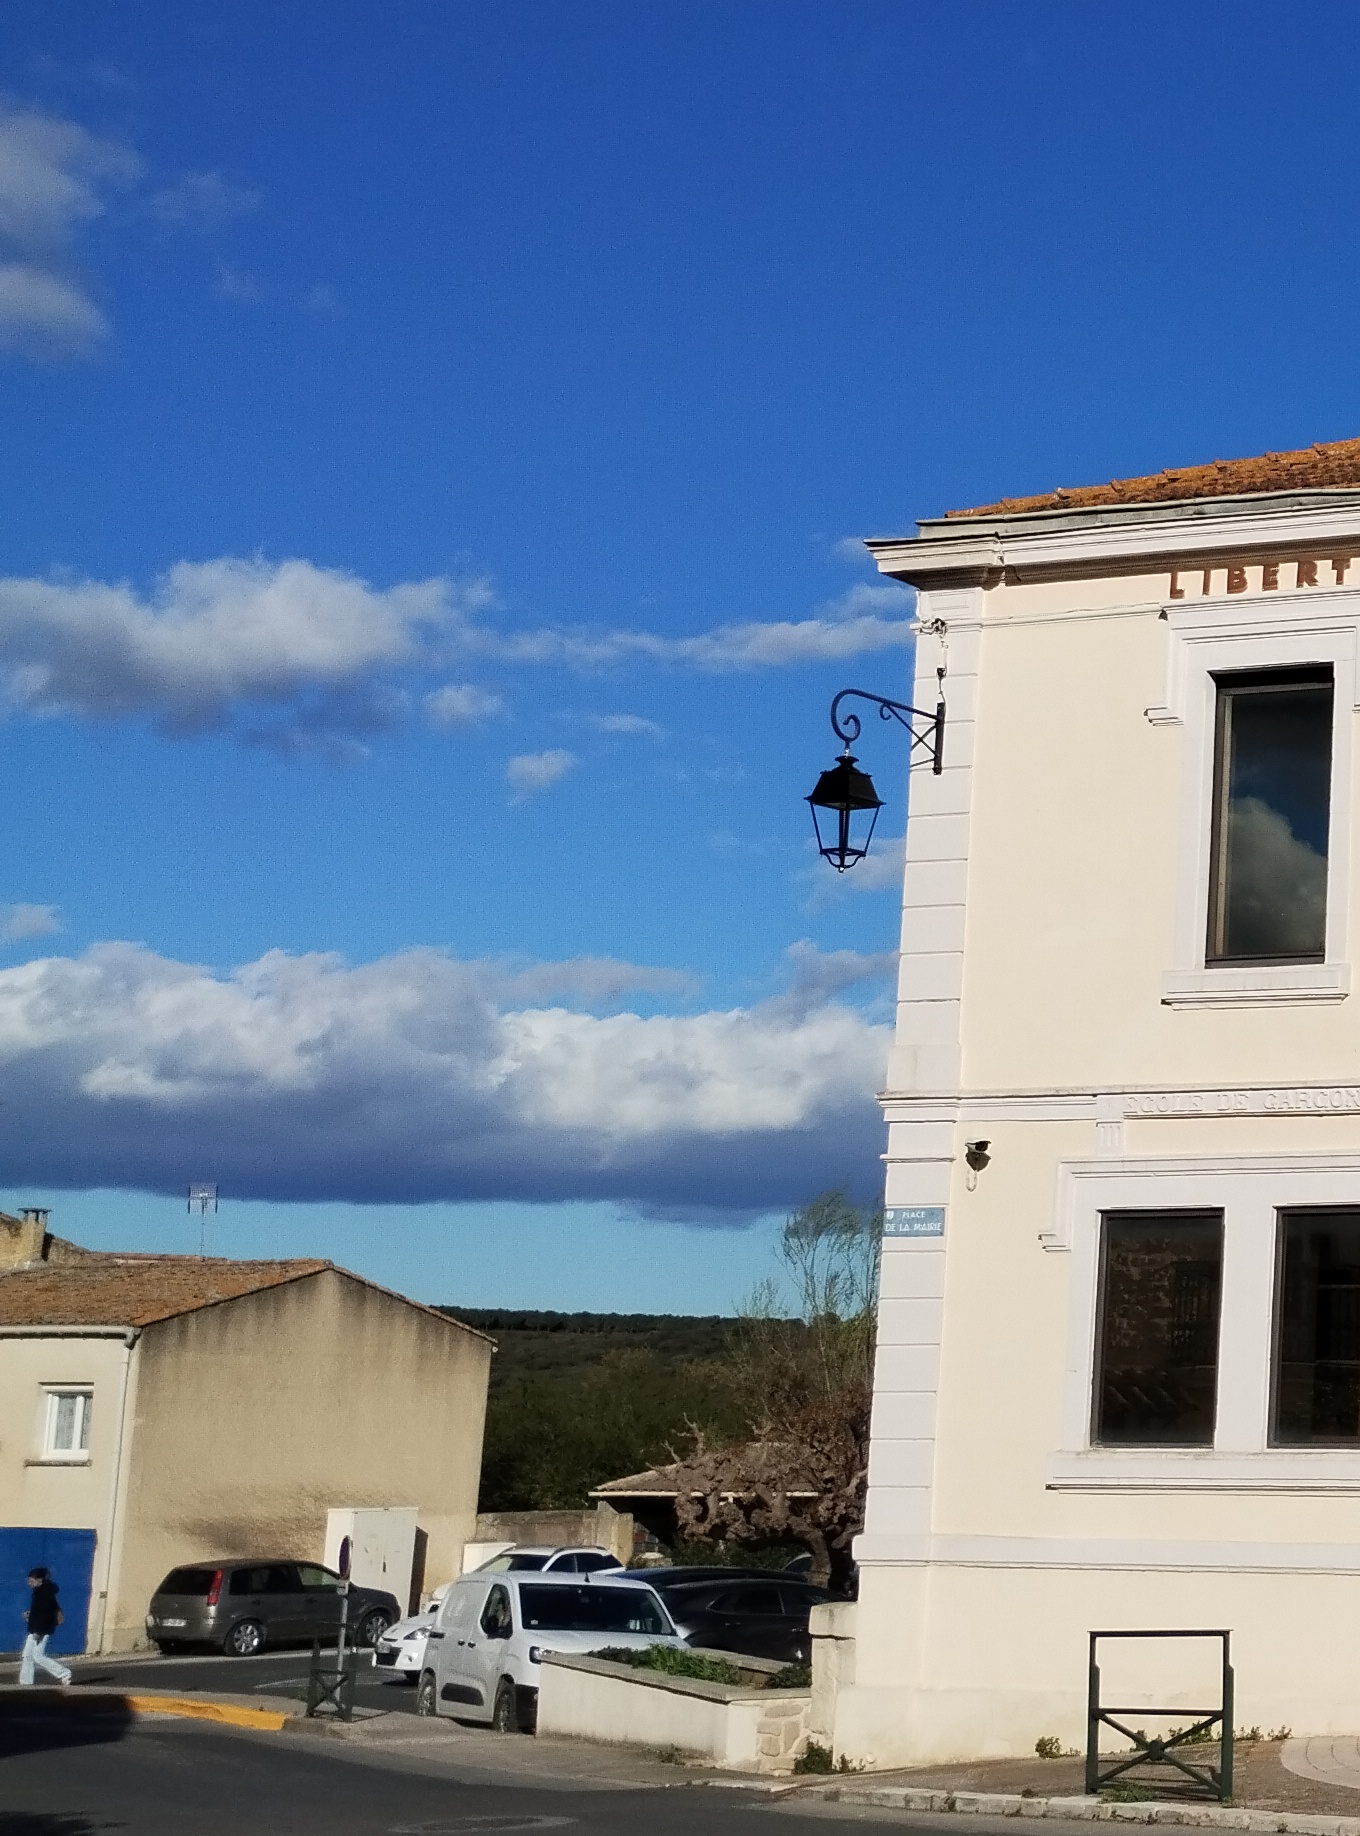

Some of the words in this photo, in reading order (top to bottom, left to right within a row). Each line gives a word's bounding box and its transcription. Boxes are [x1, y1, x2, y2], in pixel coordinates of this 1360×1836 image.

[1123, 1096, 1204, 1114] ECOLE
[1216, 1094, 1249, 1112] DE
[902, 1211, 925, 1219] PLACE
[885, 1223, 896, 1231] DE
[899, 1223, 910, 1231] LA
[913, 1222, 942, 1231] MAIRIE
